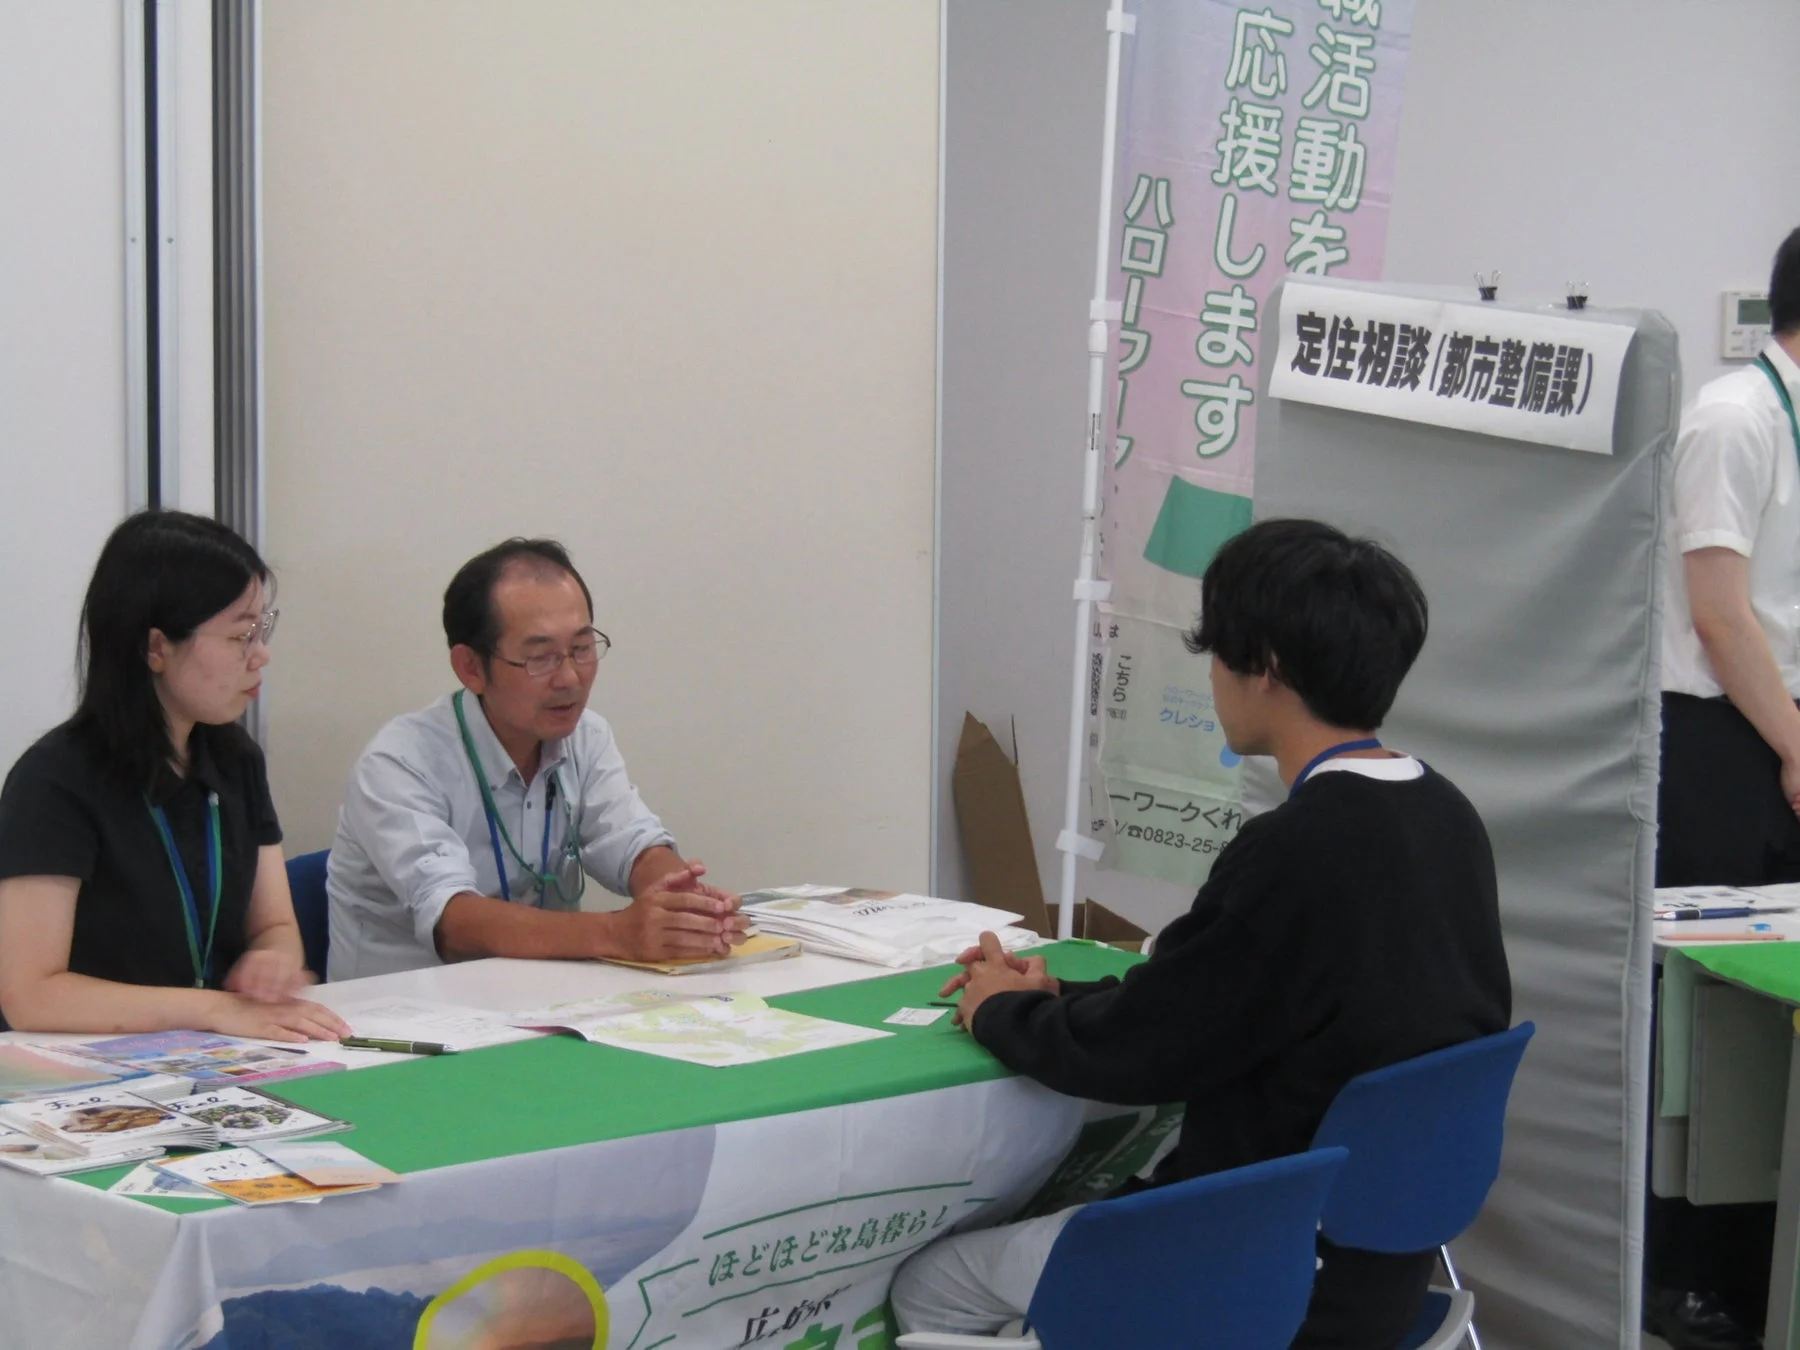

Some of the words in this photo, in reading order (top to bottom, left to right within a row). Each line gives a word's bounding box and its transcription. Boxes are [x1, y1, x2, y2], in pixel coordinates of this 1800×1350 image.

[1180, 8, 1294, 458] 応援します
[1290, 311, 1593, 418] 定住相談（都市整備課）
[708, 1205, 948, 1286] ほどほどな島暮らし
